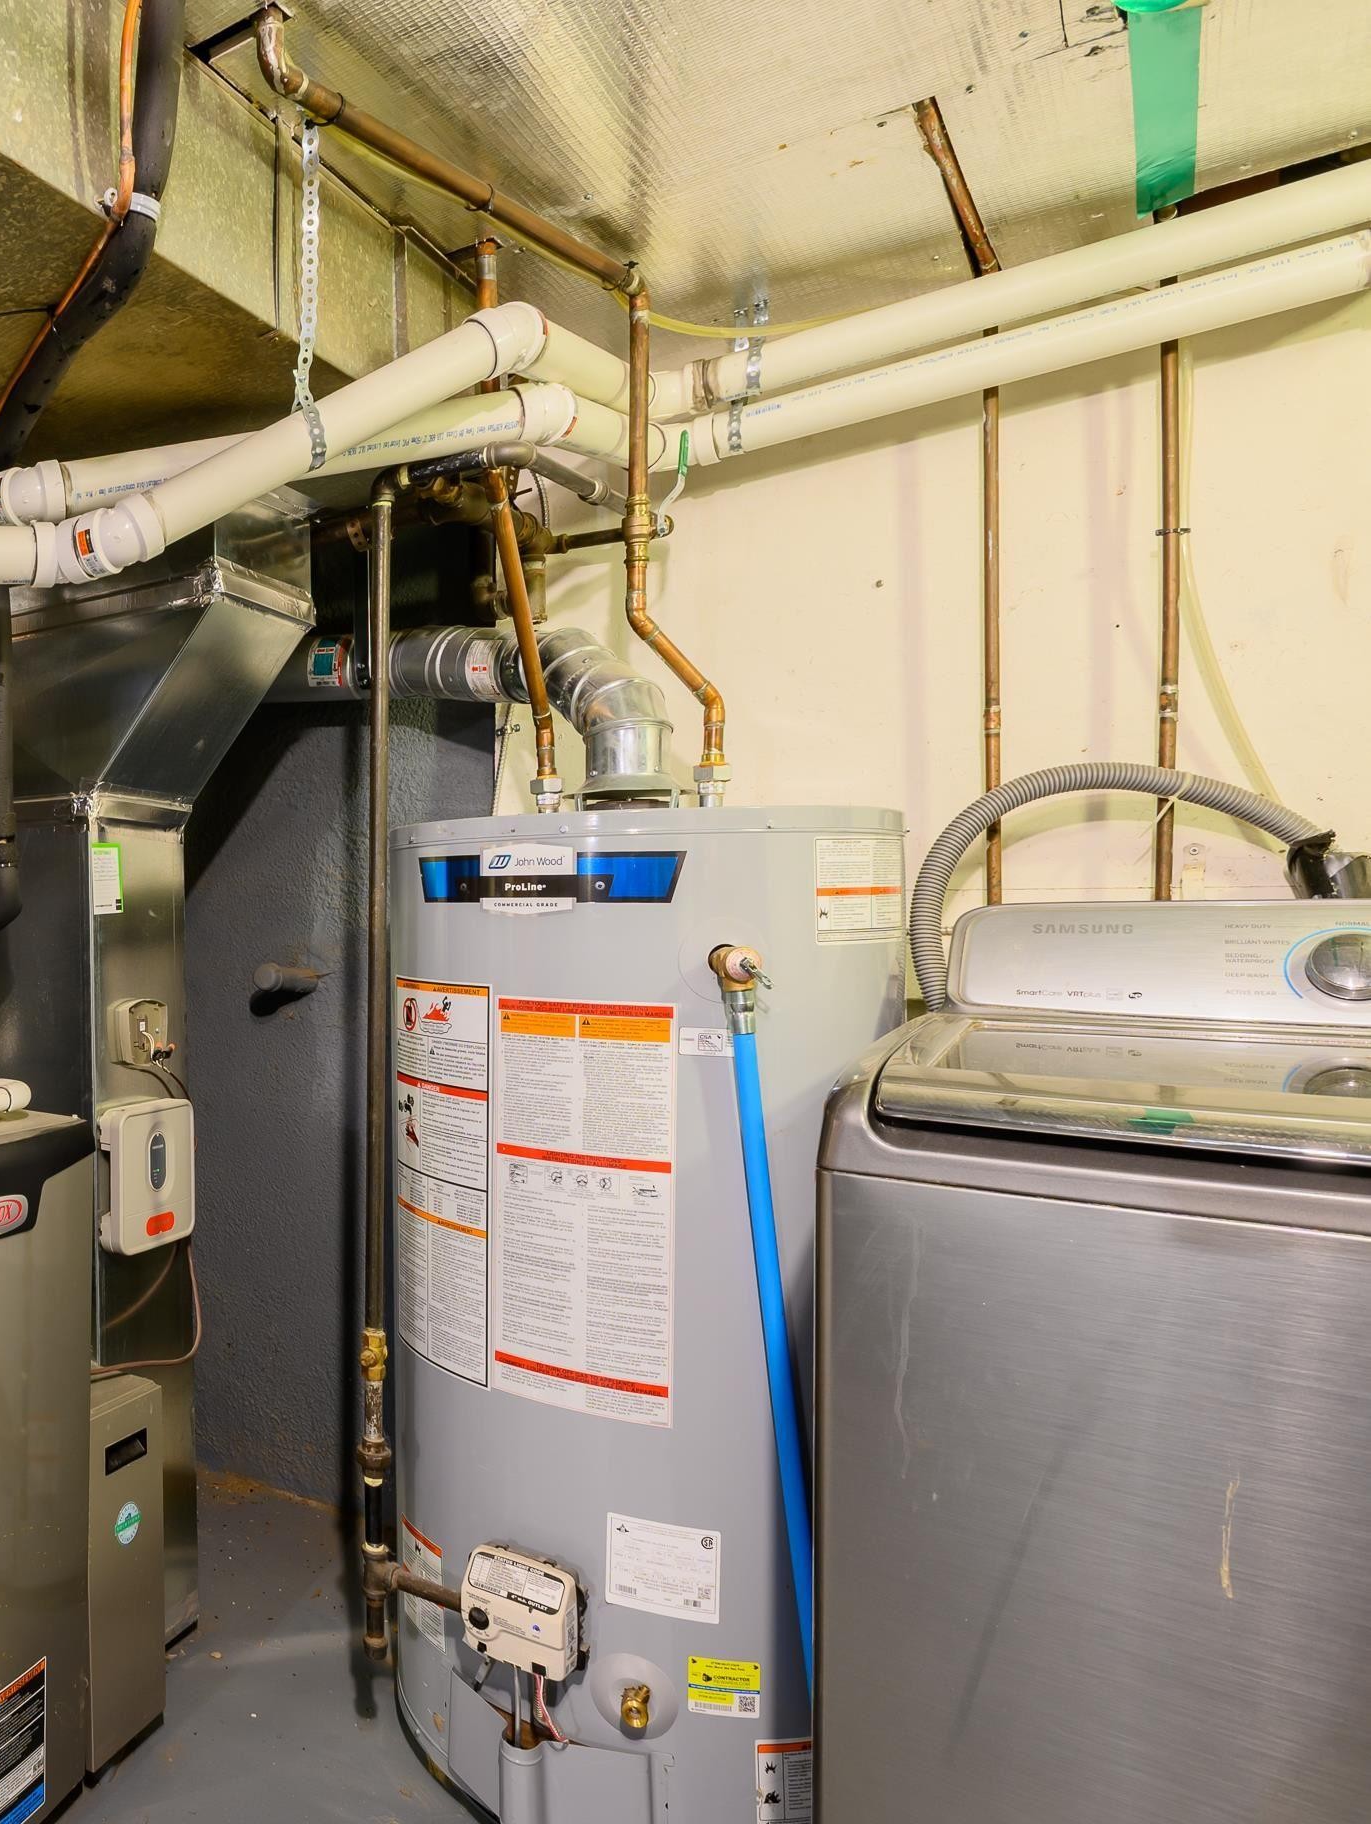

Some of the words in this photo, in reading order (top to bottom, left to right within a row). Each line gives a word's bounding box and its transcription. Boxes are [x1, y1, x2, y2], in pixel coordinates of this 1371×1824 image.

[514, 857, 535, 867] John
[537, 856, 563, 866] Wood
[1032, 923, 1134, 935] SAMSUNG
[436, 986, 481, 996] AVERTISSEMENT
[421, 1082, 440, 1093] DANGER
[527, 1600, 548, 1612] OUTLET
[713, 1674, 751, 1682] CONTRACTOR
